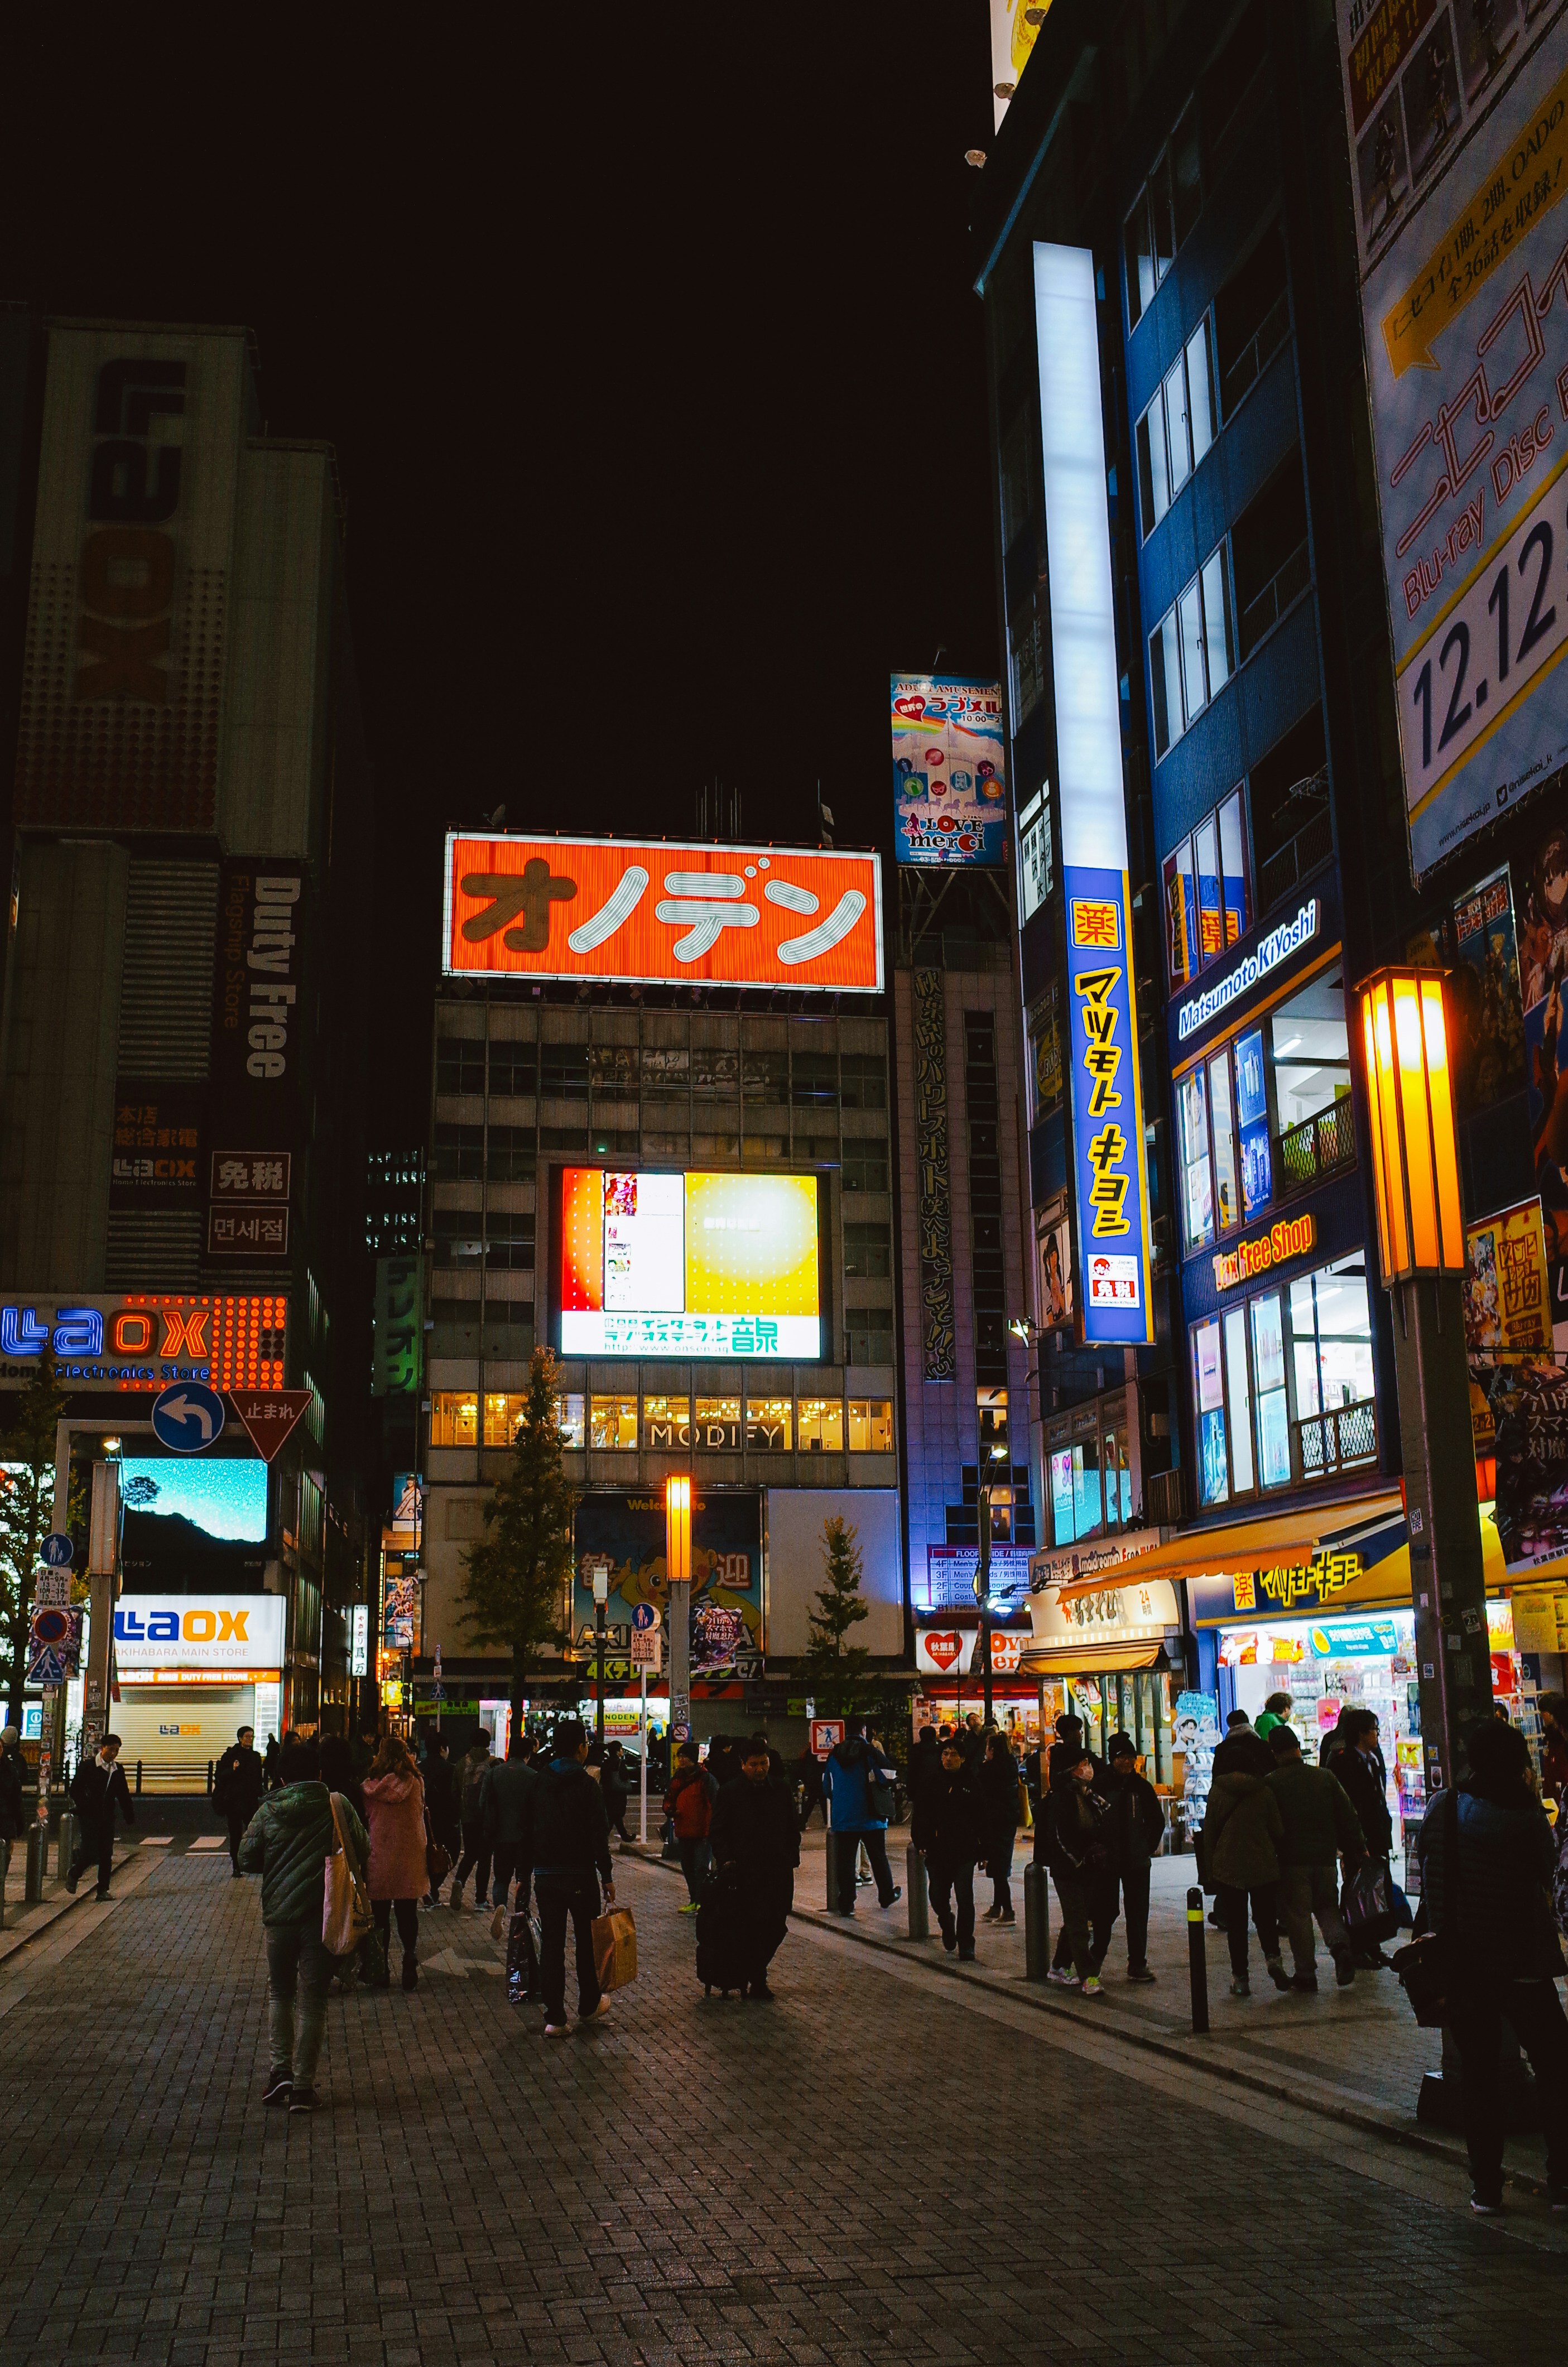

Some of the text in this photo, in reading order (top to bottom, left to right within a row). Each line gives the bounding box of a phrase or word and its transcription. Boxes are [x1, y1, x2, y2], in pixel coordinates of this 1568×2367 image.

[1402, 405, 1554, 619] Blu-ray Disc
[897, 682, 1001, 696] ADUT AMUSEMEN
[925, 815, 984, 833] LOVE
[461, 854, 867, 965] オノデン
[1076, 904, 1115, 945] 薬
[246, 877, 301, 1078] Duty Free
[224, 969, 246, 1029] Store
[1179, 956, 1257, 1041] Matsumoto
[218, 1160, 284, 1191] 免税
[214, 1218, 284, 1242] 면세점
[1213, 1214, 1312, 1291] Tax Free Shop
[1097, 1280, 1132, 1298] 免税
[732, 1317, 778, 1352] 音泉
[56, 1362, 155, 1380] Electronics
[161, 1363, 210, 1381] Store
[245, 1403, 295, 1420] 止まれ
[650, 1424, 780, 1446] MODIFY
[627, 1499, 666, 1511] Welco
[716, 1553, 751, 1587] 迎
[1139, 1589, 1149, 1604] 24
[114, 1647, 249, 1657] AKIHABARA MAIN STORE
[223, 1673, 248, 1681] STORE
